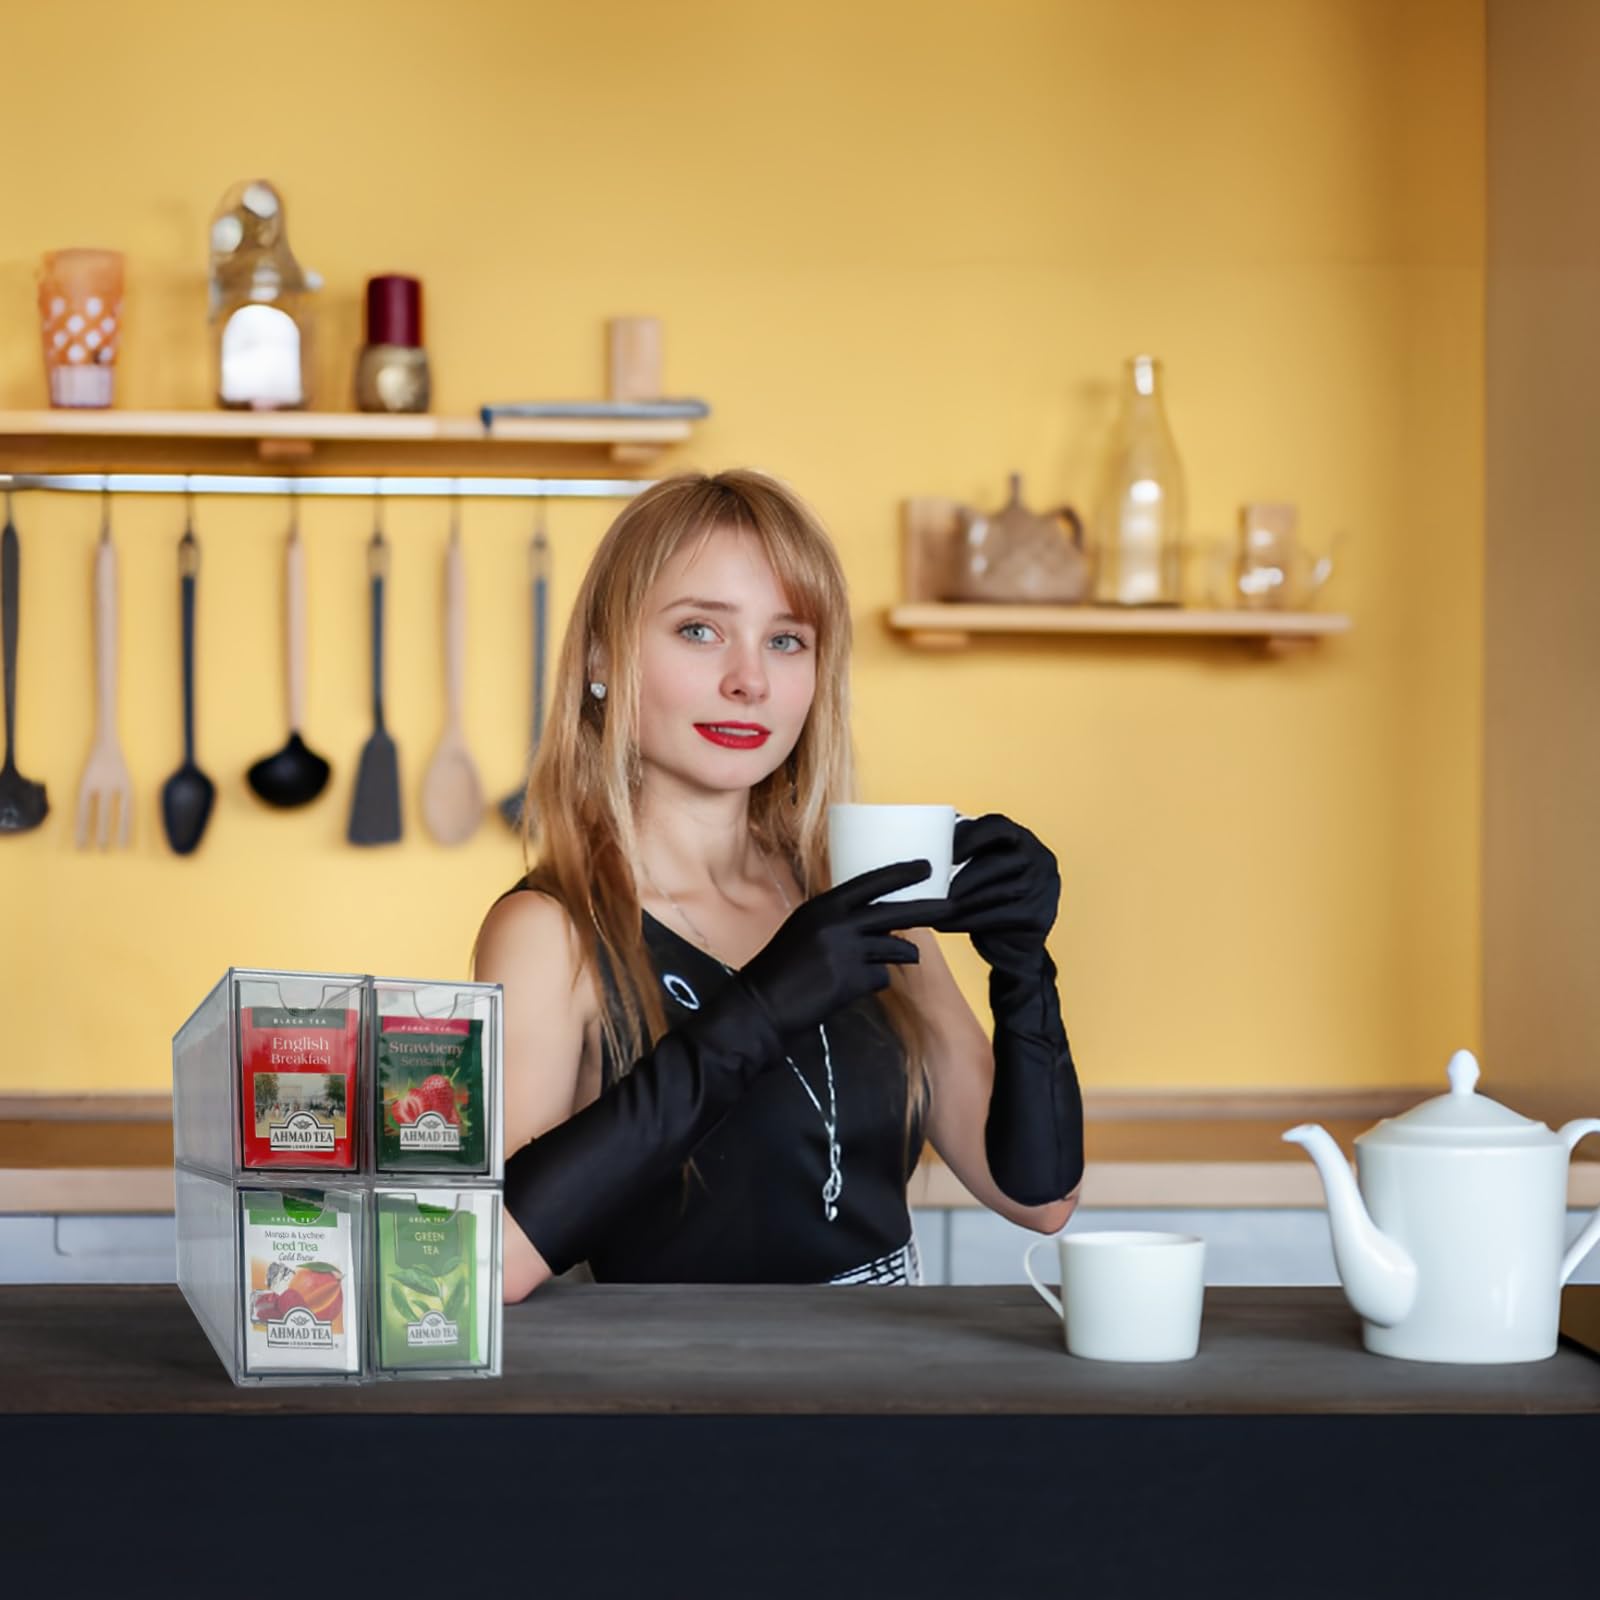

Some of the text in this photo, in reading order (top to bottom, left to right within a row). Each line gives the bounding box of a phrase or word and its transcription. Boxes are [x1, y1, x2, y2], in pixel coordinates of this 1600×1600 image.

[272, 1036, 329, 1053] English
[388, 1041, 465, 1058] Strawberry
[271, 1053, 331, 1065] Breakfast
[272, 1131, 333, 1143] AHMAD TEA
[402, 1131, 458, 1142] AHMAD TEA
[265, 1231, 290, 1239] Mango
[414, 1232, 445, 1241] GREEN
[272, 1240, 319, 1252] Iced Tea
[423, 1245, 440, 1255] TEA
[270, 1327, 331, 1340] AHMAD TEA
[409, 1328, 457, 1339] AHMAD TEA
